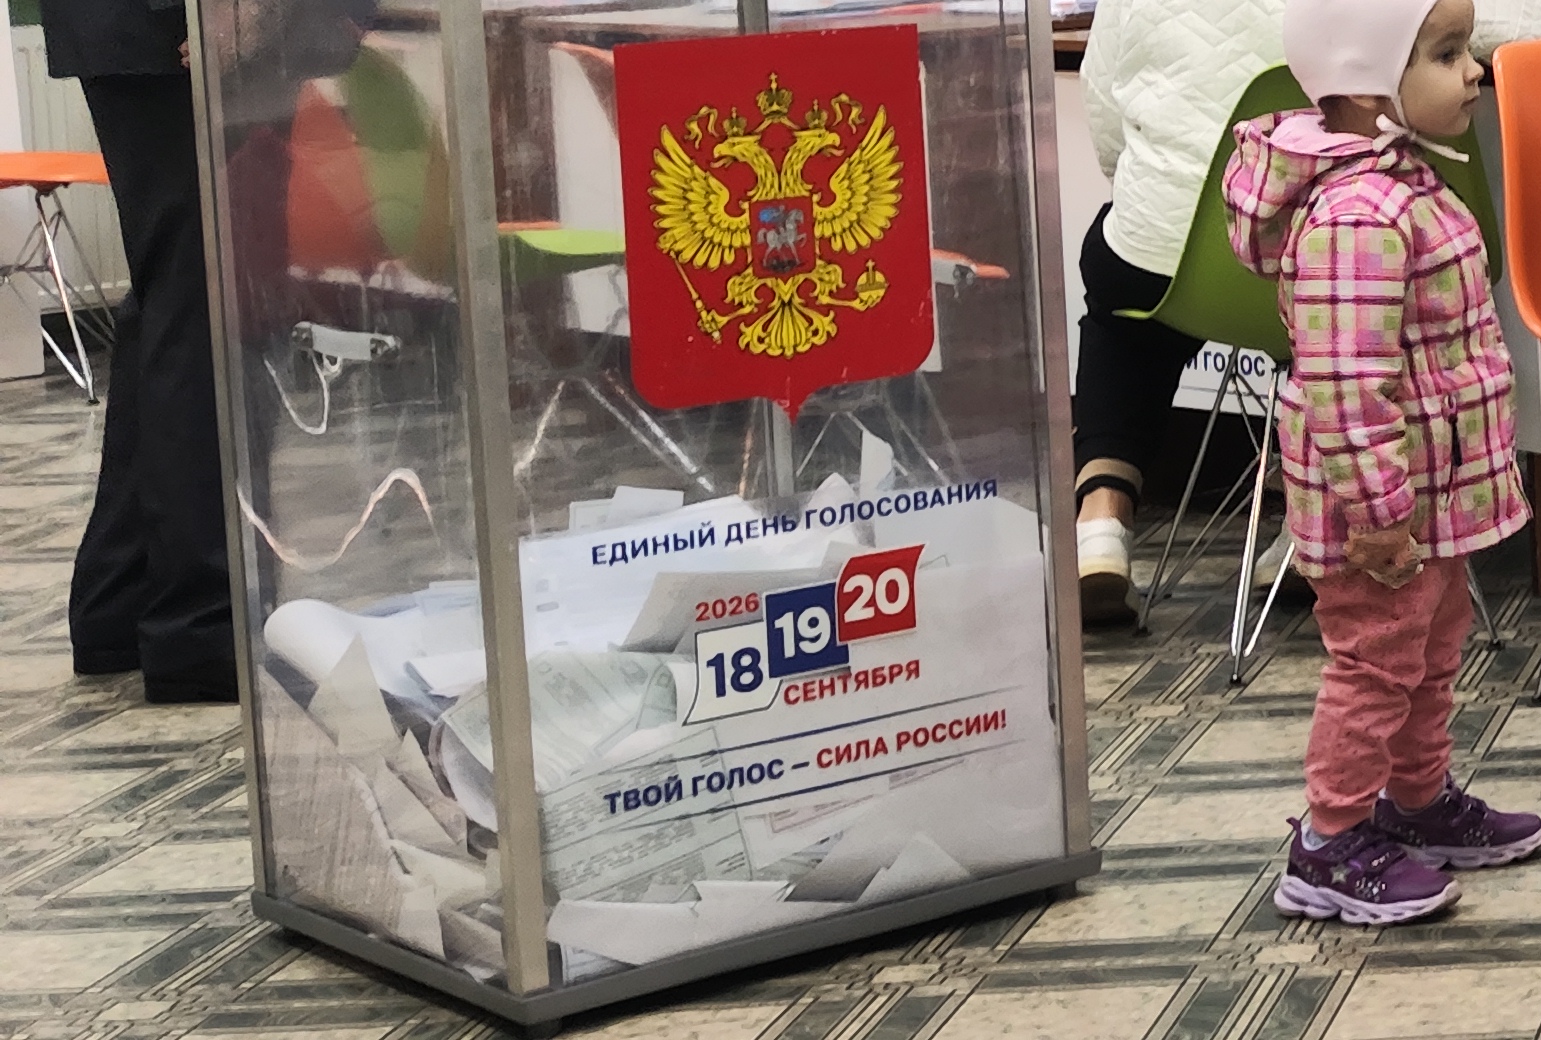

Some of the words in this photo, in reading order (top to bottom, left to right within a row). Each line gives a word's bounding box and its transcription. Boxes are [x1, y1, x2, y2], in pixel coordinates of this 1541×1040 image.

[1203, 351, 1266, 377] ГООС
[592, 520, 716, 566] ЕДИНЫЙ
[724, 515, 797, 547] ДЕНЬ
[805, 478, 998, 529] ГОЛОСОВАНИЯ
[695, 591, 760, 622] 2026
[706, 647, 764, 698] 18
[774, 606, 831, 659] 19
[843, 567, 910, 623] 20
[783, 659, 920, 706] СЕНТЯБРЯ
[603, 775, 684, 815] ТВОЙ
[691, 758, 785, 797] ГОЛОС
[816, 735, 888, 769] СИЛА
[896, 709, 1008, 751] РОССИИ!
